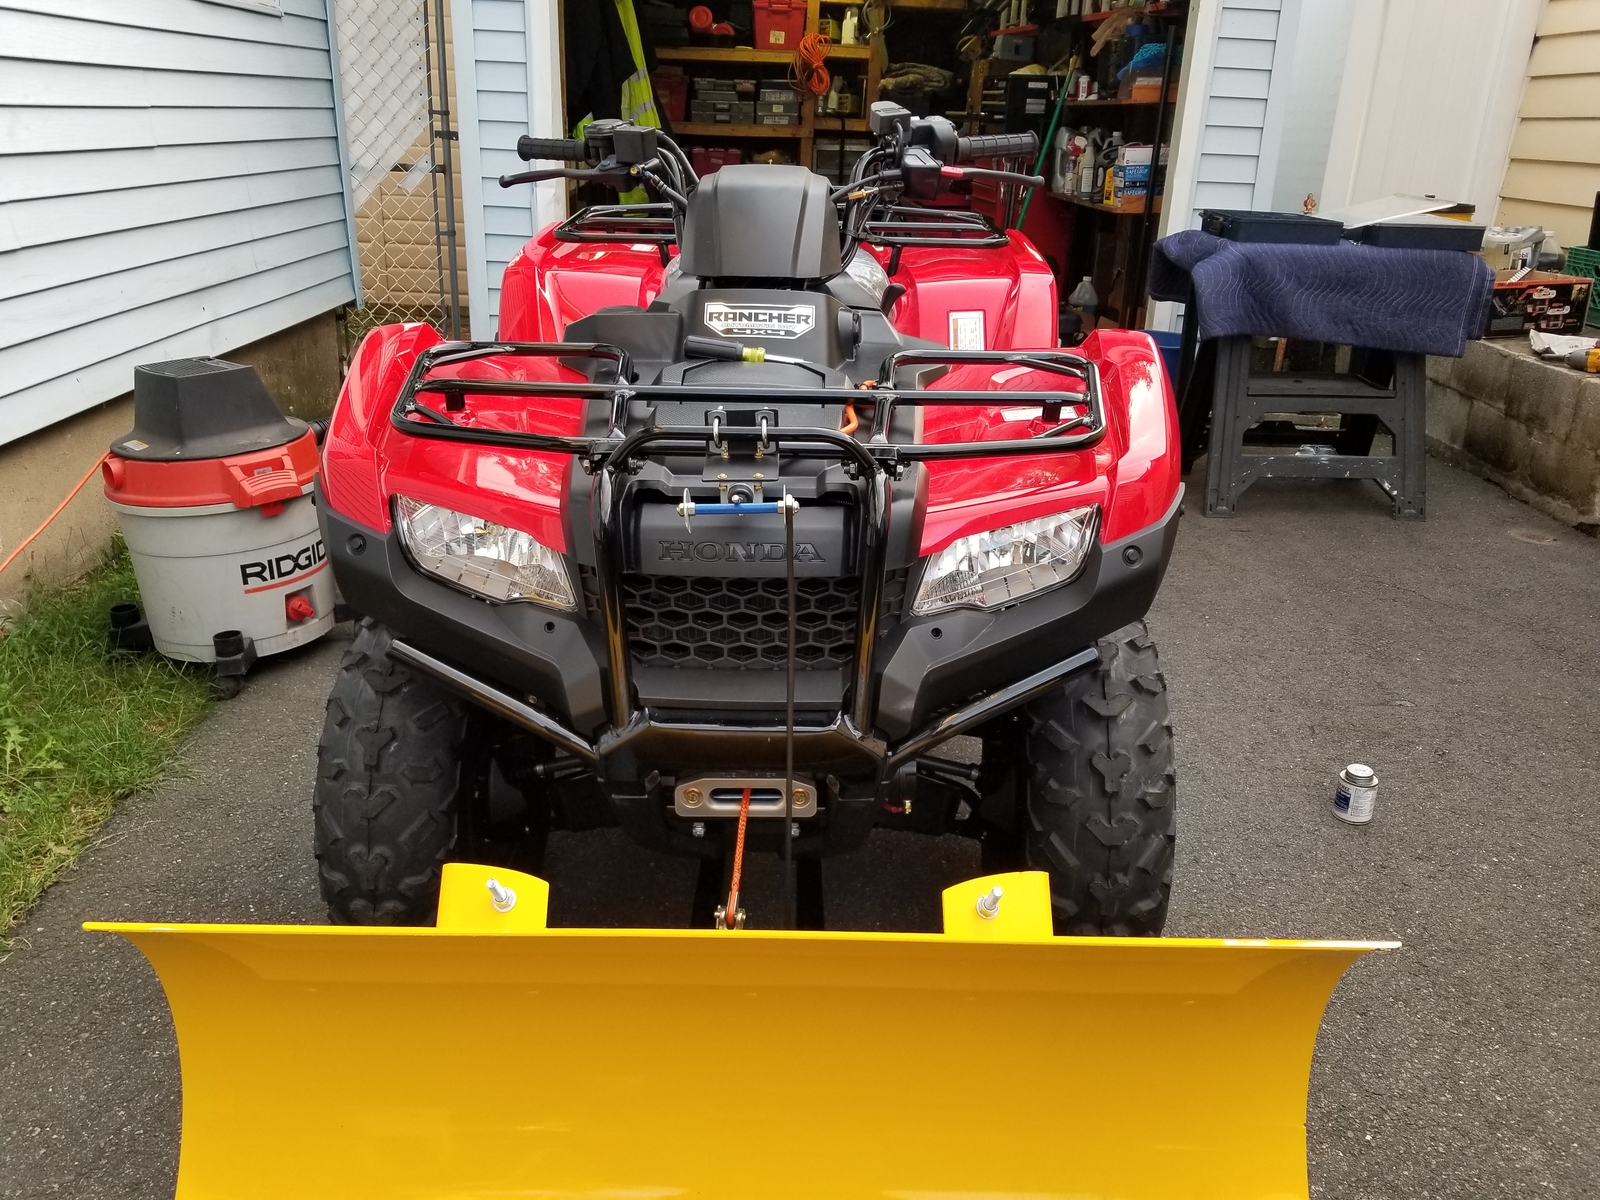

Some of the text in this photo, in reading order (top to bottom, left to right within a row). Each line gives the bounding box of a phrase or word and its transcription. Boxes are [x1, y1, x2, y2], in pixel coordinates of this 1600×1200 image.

[708, 311, 812, 325] RANCHER
[239, 538, 327, 586] RIDGID
[658, 540, 827, 563] HONDA
